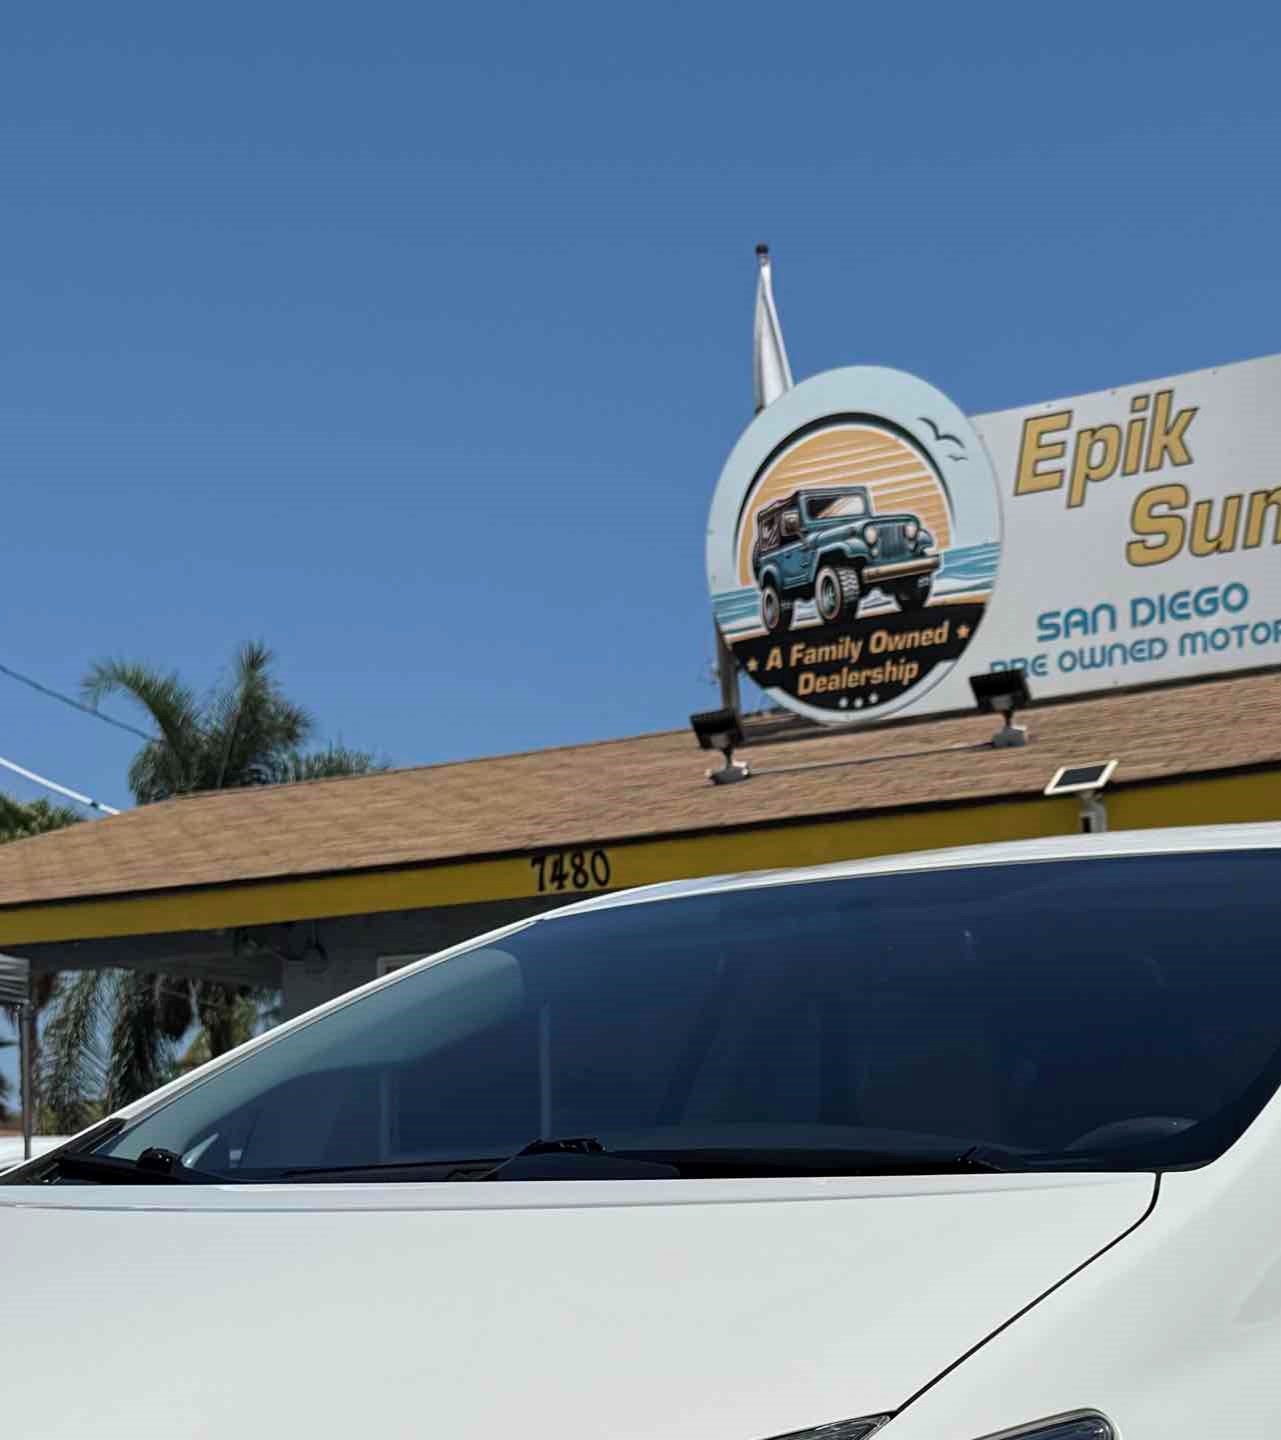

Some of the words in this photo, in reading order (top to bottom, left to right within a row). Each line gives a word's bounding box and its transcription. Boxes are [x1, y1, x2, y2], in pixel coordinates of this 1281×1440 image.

[1013, 389, 1200, 509] Epik
[1036, 603, 1117, 642] SAN
[1130, 582, 1249, 628] DIEGO
[765, 648, 783, 671] A
[789, 636, 863, 667] Family
[870, 620, 950, 653] Owned
[1057, 637, 1168, 673] OWNED
[798, 657, 920, 696] Dealership
[530, 850, 611, 892] 7480
